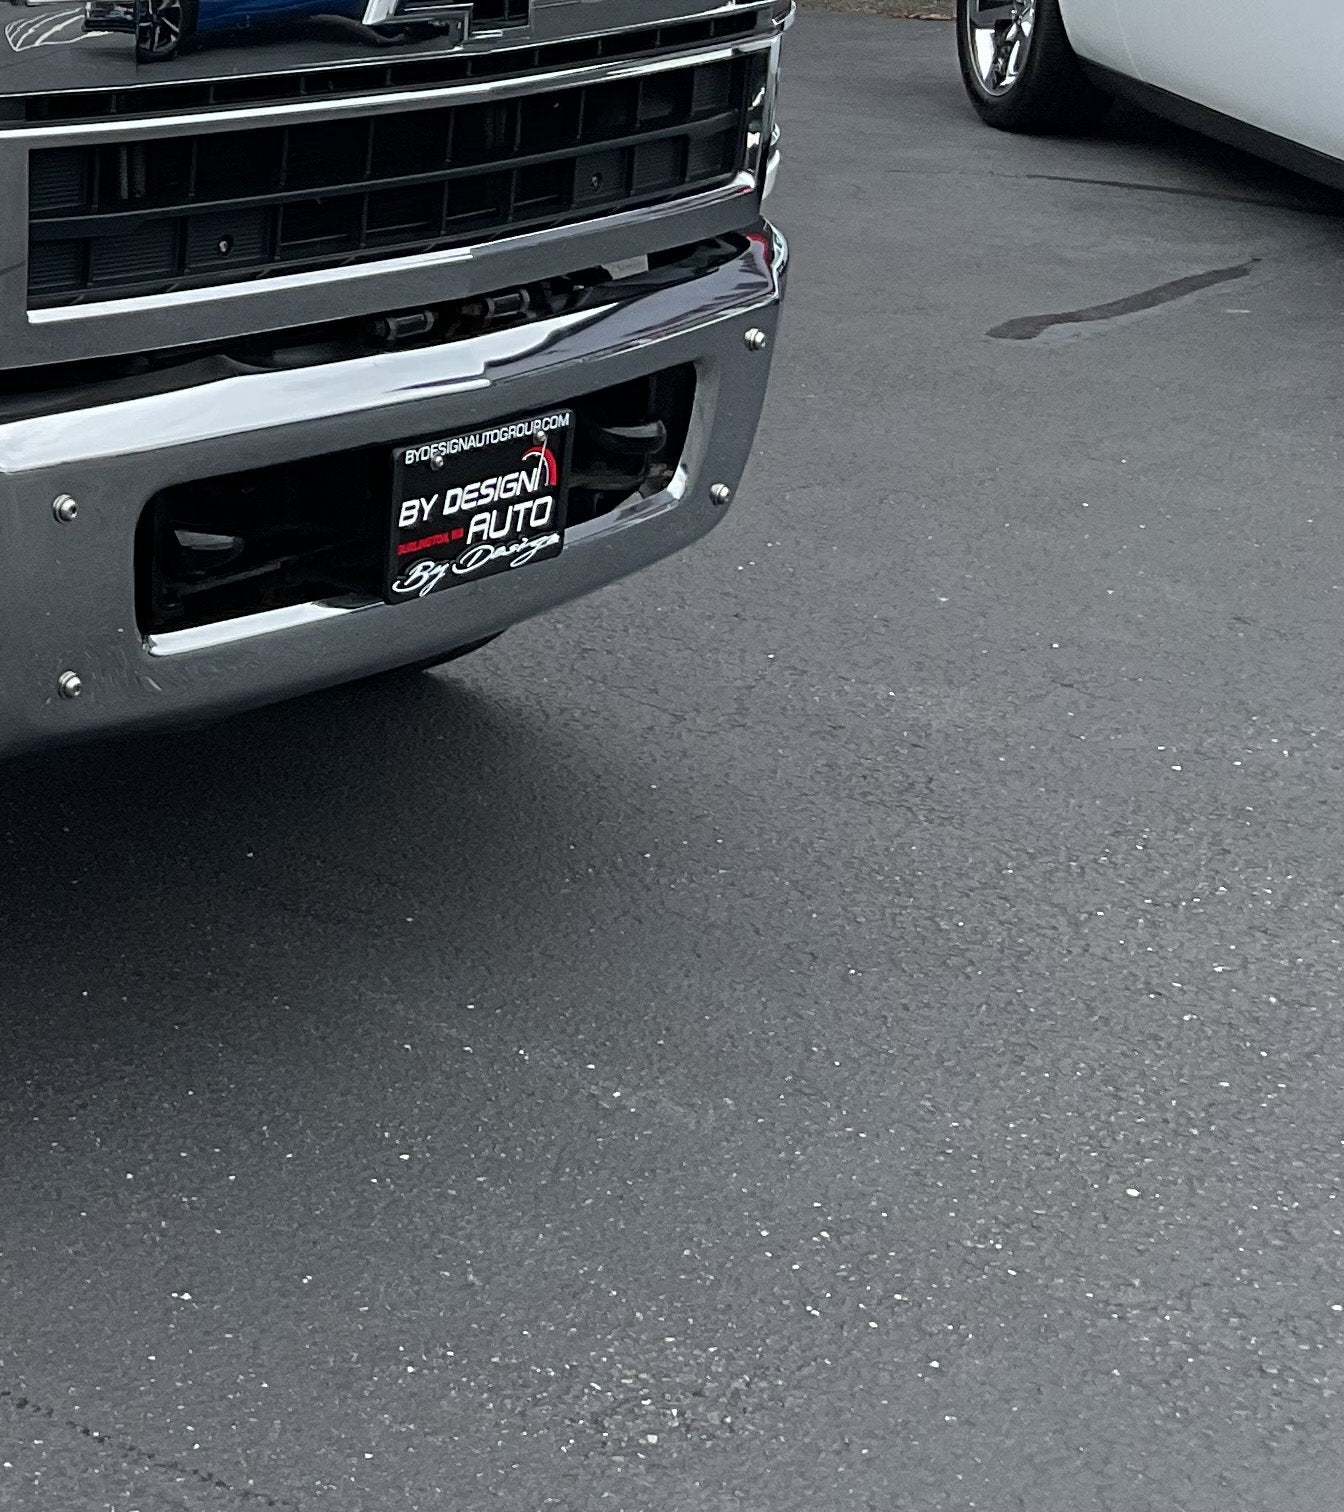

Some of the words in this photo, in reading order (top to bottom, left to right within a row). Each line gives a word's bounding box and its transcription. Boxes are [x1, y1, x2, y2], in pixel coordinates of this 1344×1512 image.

[405, 413, 570, 465] BYDESIGNAUTOGROUP.COM
[398, 494, 439, 528] BY
[443, 466, 540, 516] DESIGN
[466, 495, 553, 545] AUTO
[391, 559, 450, 597] By
[452, 532, 560, 574] Design
